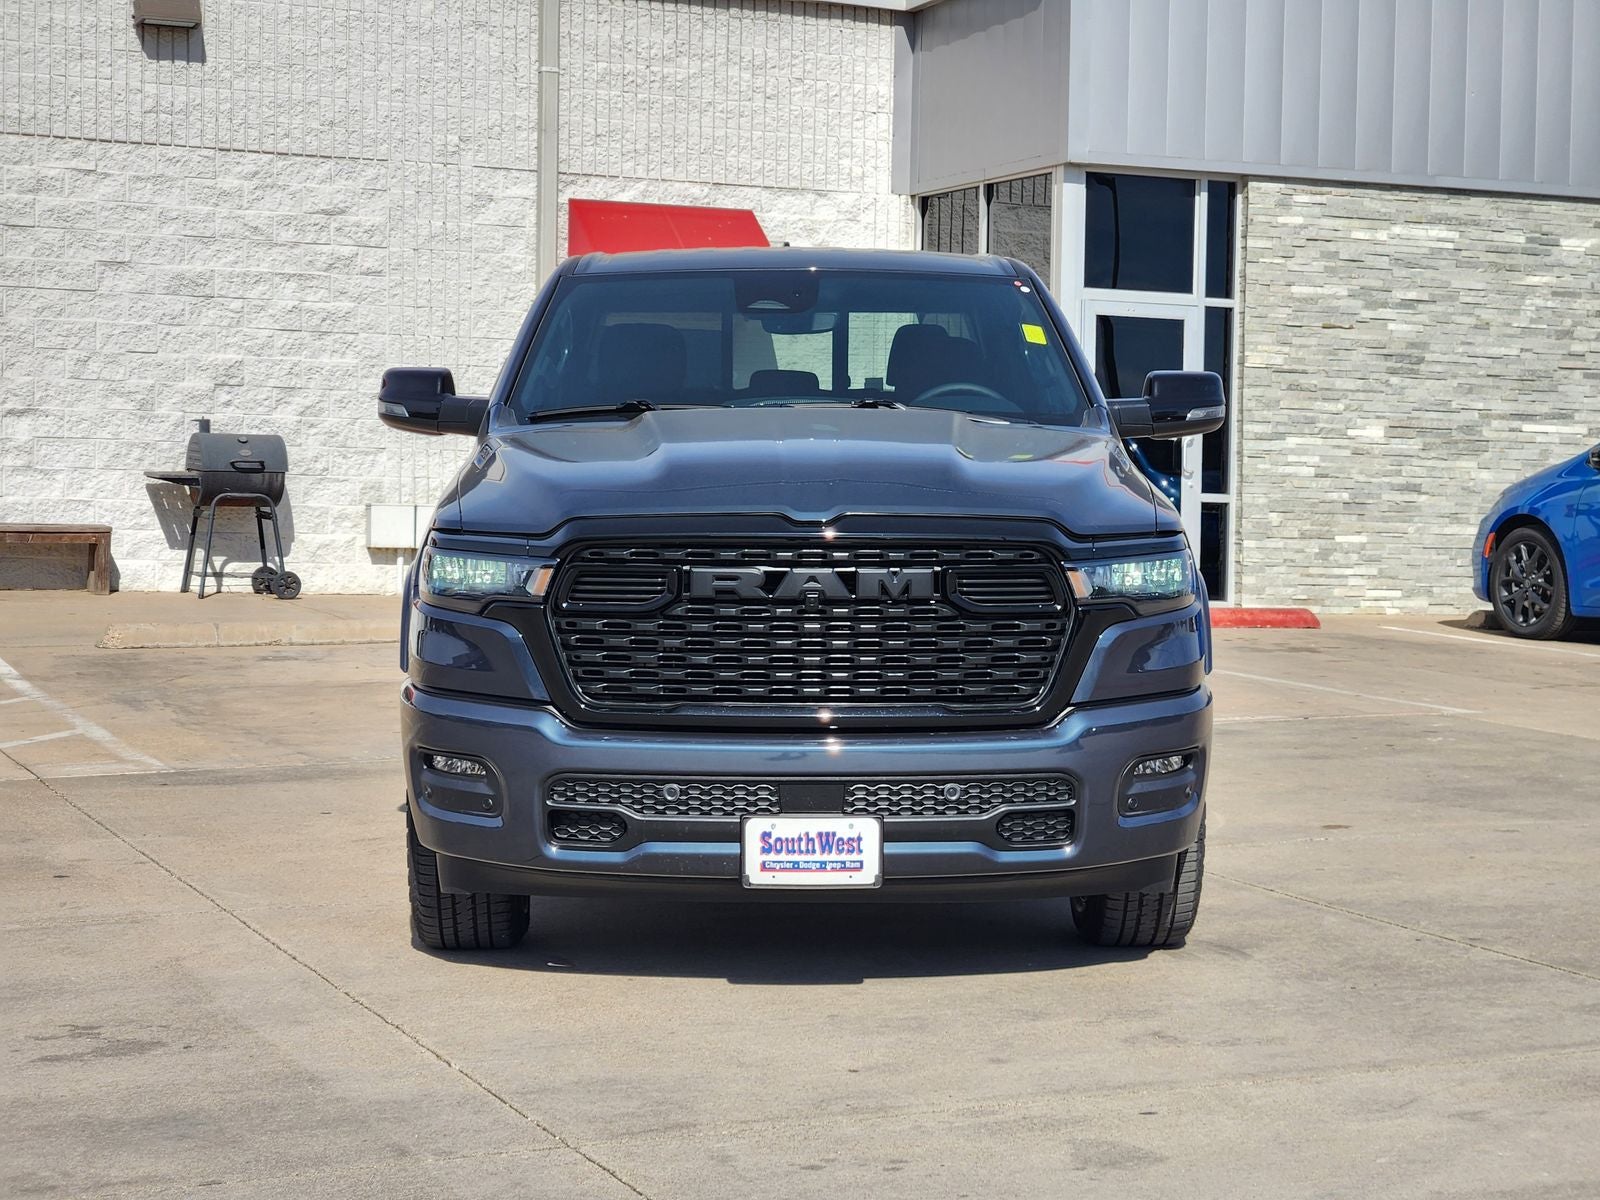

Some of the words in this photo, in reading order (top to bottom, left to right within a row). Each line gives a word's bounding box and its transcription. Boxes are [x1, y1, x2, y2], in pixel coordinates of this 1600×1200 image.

[689, 566, 935, 600] RAM
[760, 831, 863, 855] SouthWest
[765, 861, 793, 869] Chrysler
[799, 861, 820, 869] Dodge
[826, 861, 842, 870] Jeep
